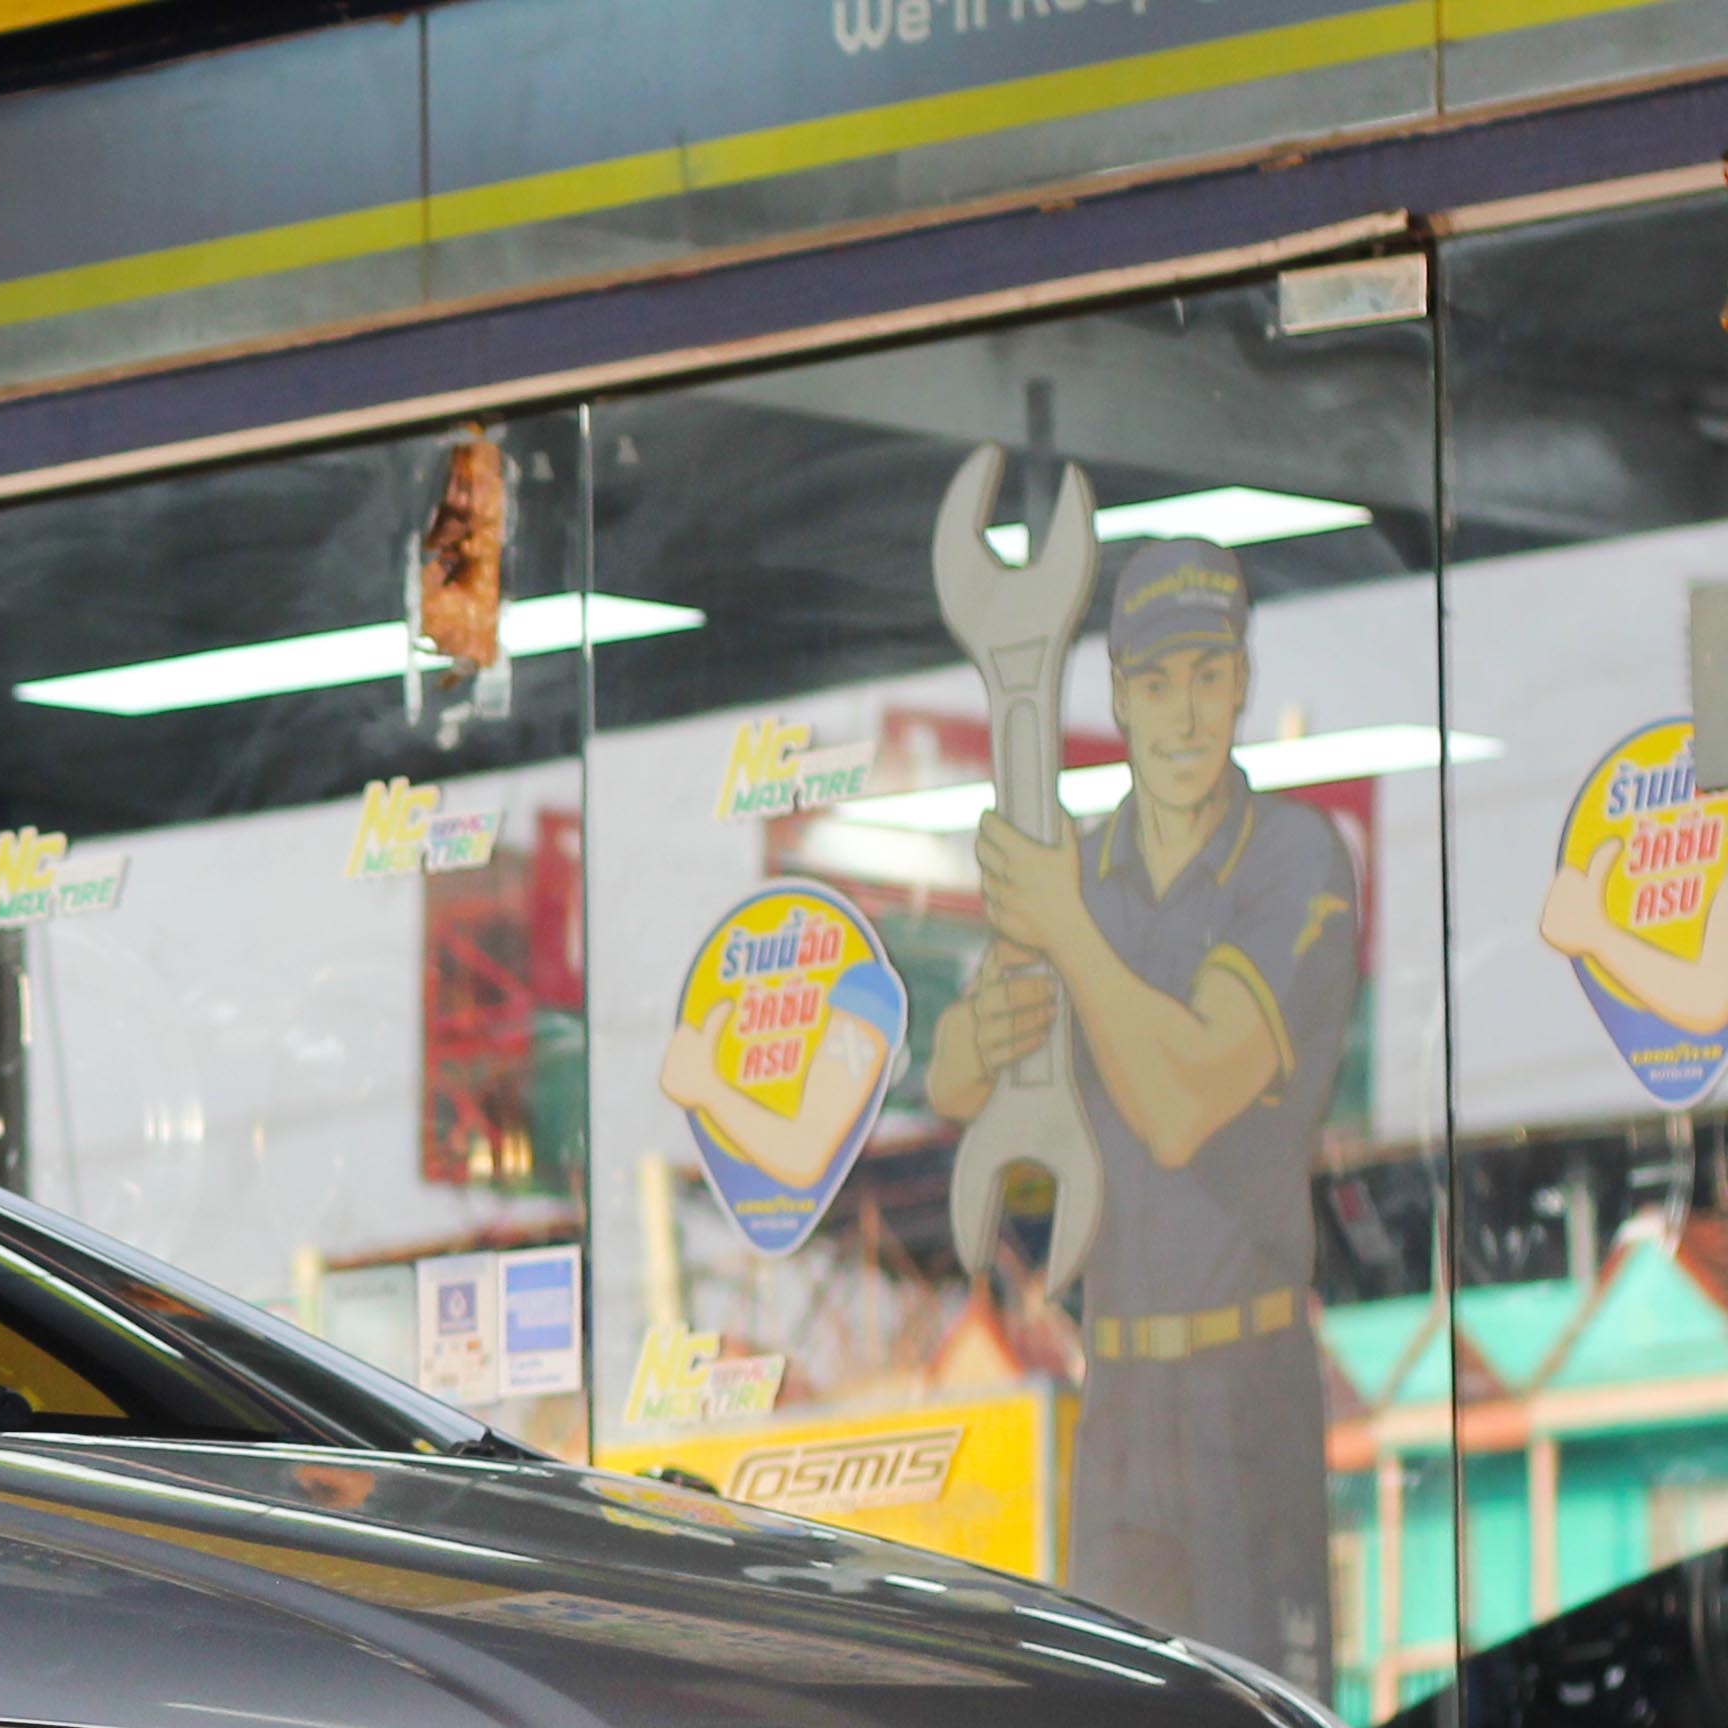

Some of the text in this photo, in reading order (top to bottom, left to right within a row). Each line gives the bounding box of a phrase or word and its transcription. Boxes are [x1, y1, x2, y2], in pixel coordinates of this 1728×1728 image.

[715, 719, 812, 822] NC
[346, 781, 438, 876] NC
[624, 1328, 721, 1424] NC
